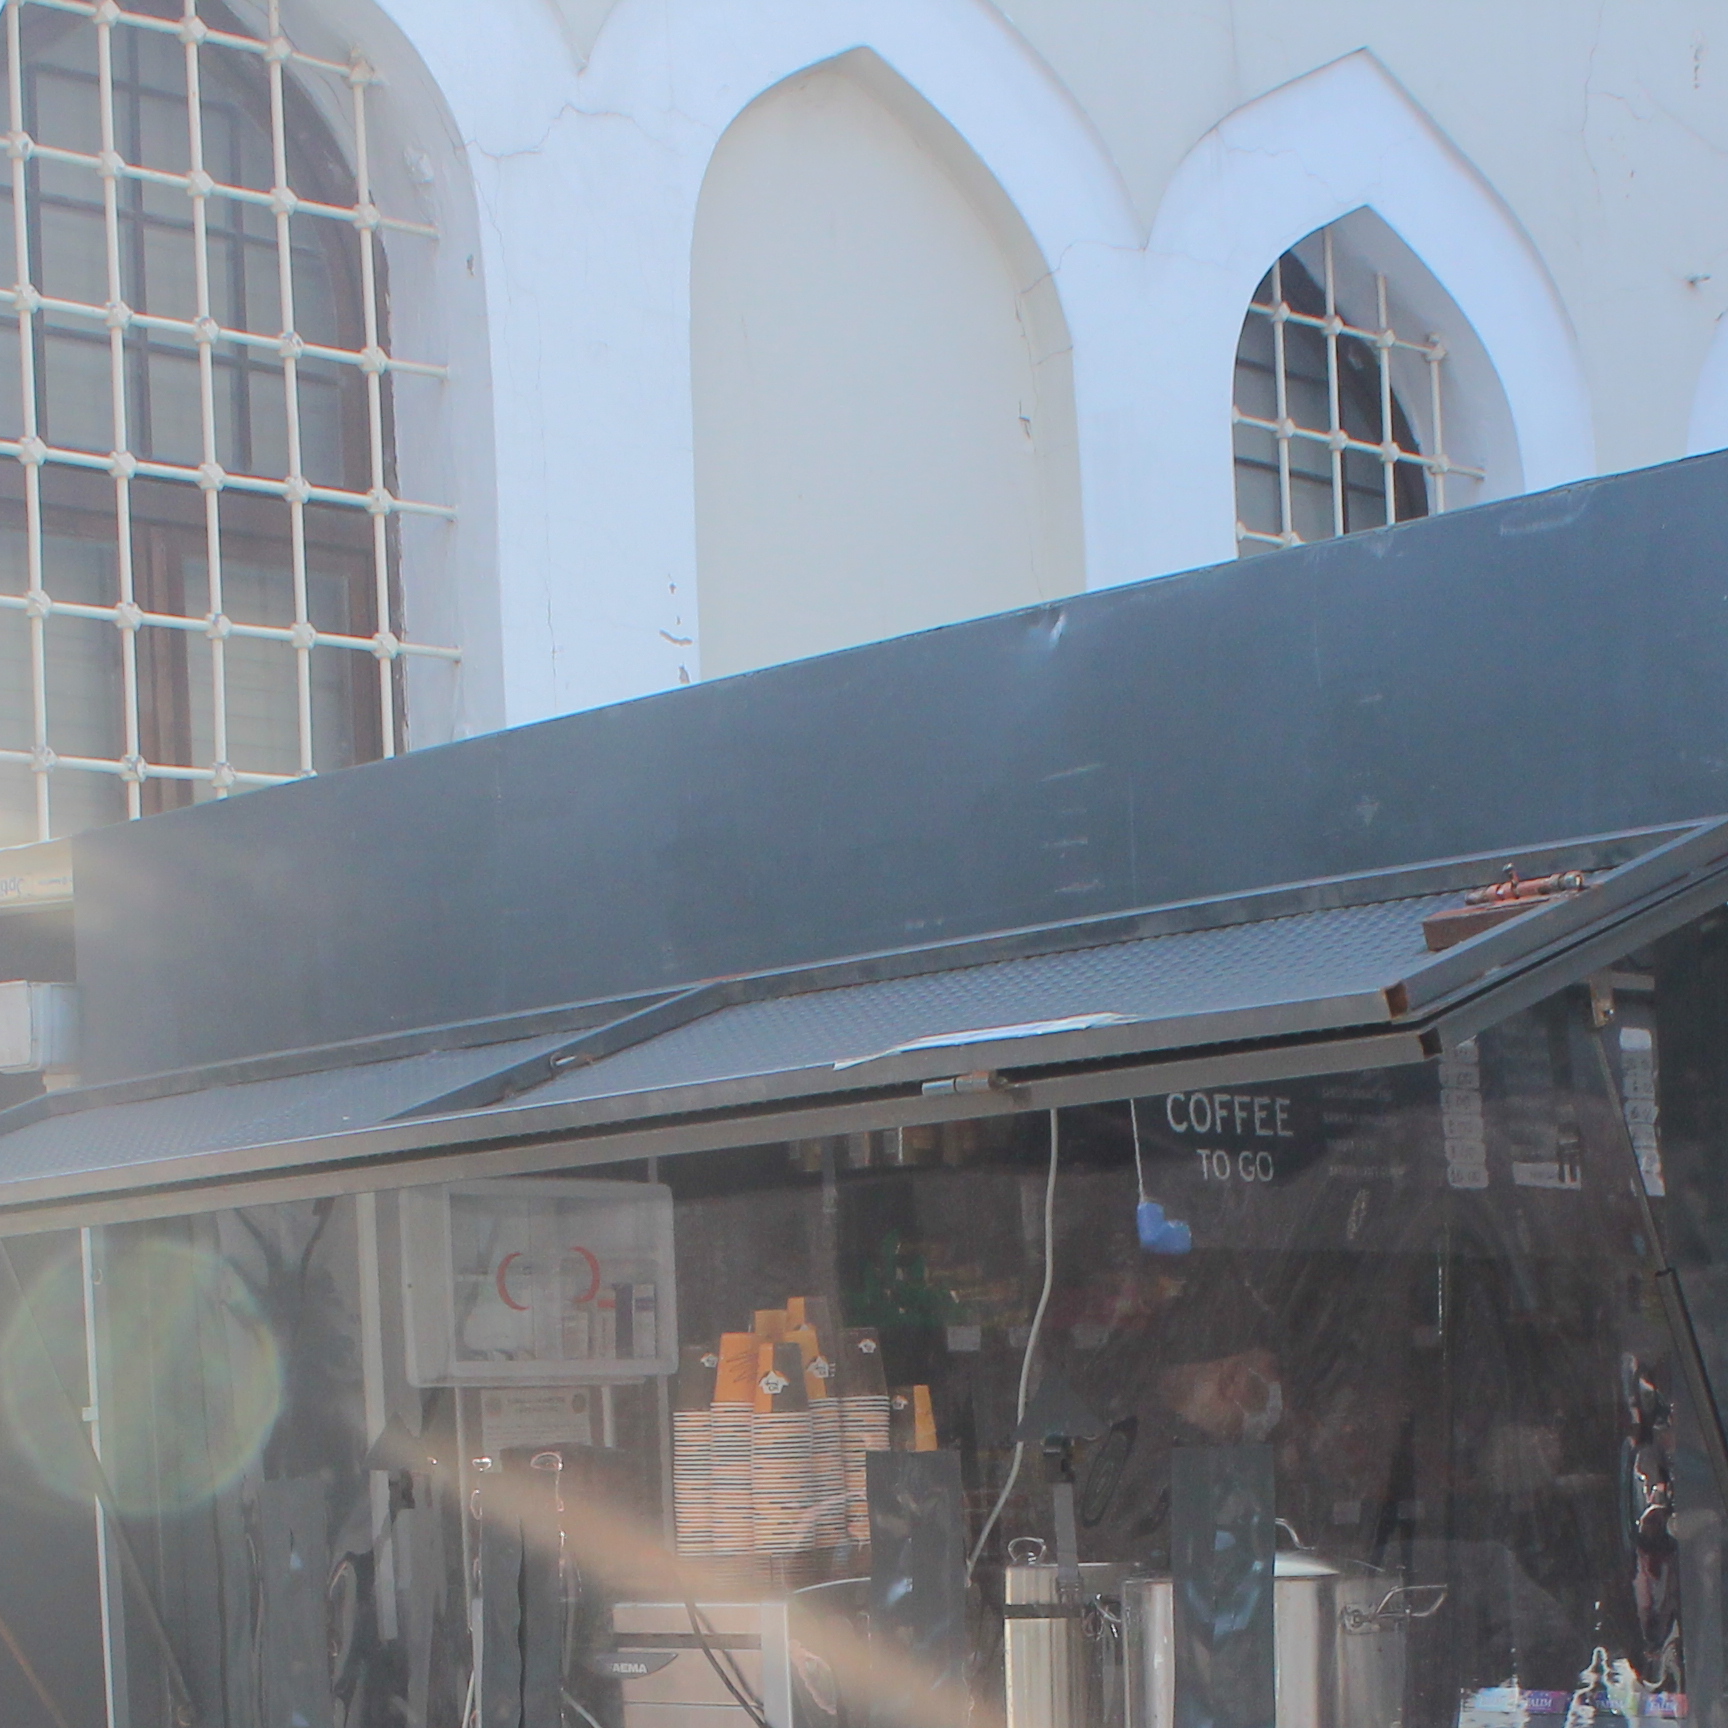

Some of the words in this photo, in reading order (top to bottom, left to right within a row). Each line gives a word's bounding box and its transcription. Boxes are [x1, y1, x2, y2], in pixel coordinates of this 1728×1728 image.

[1165, 1092, 1294, 1137] COFFEE
[1196, 1150, 1233, 1181] TO
[1238, 1152, 1275, 1183] GO
[609, 1662, 648, 1674] AEMA
